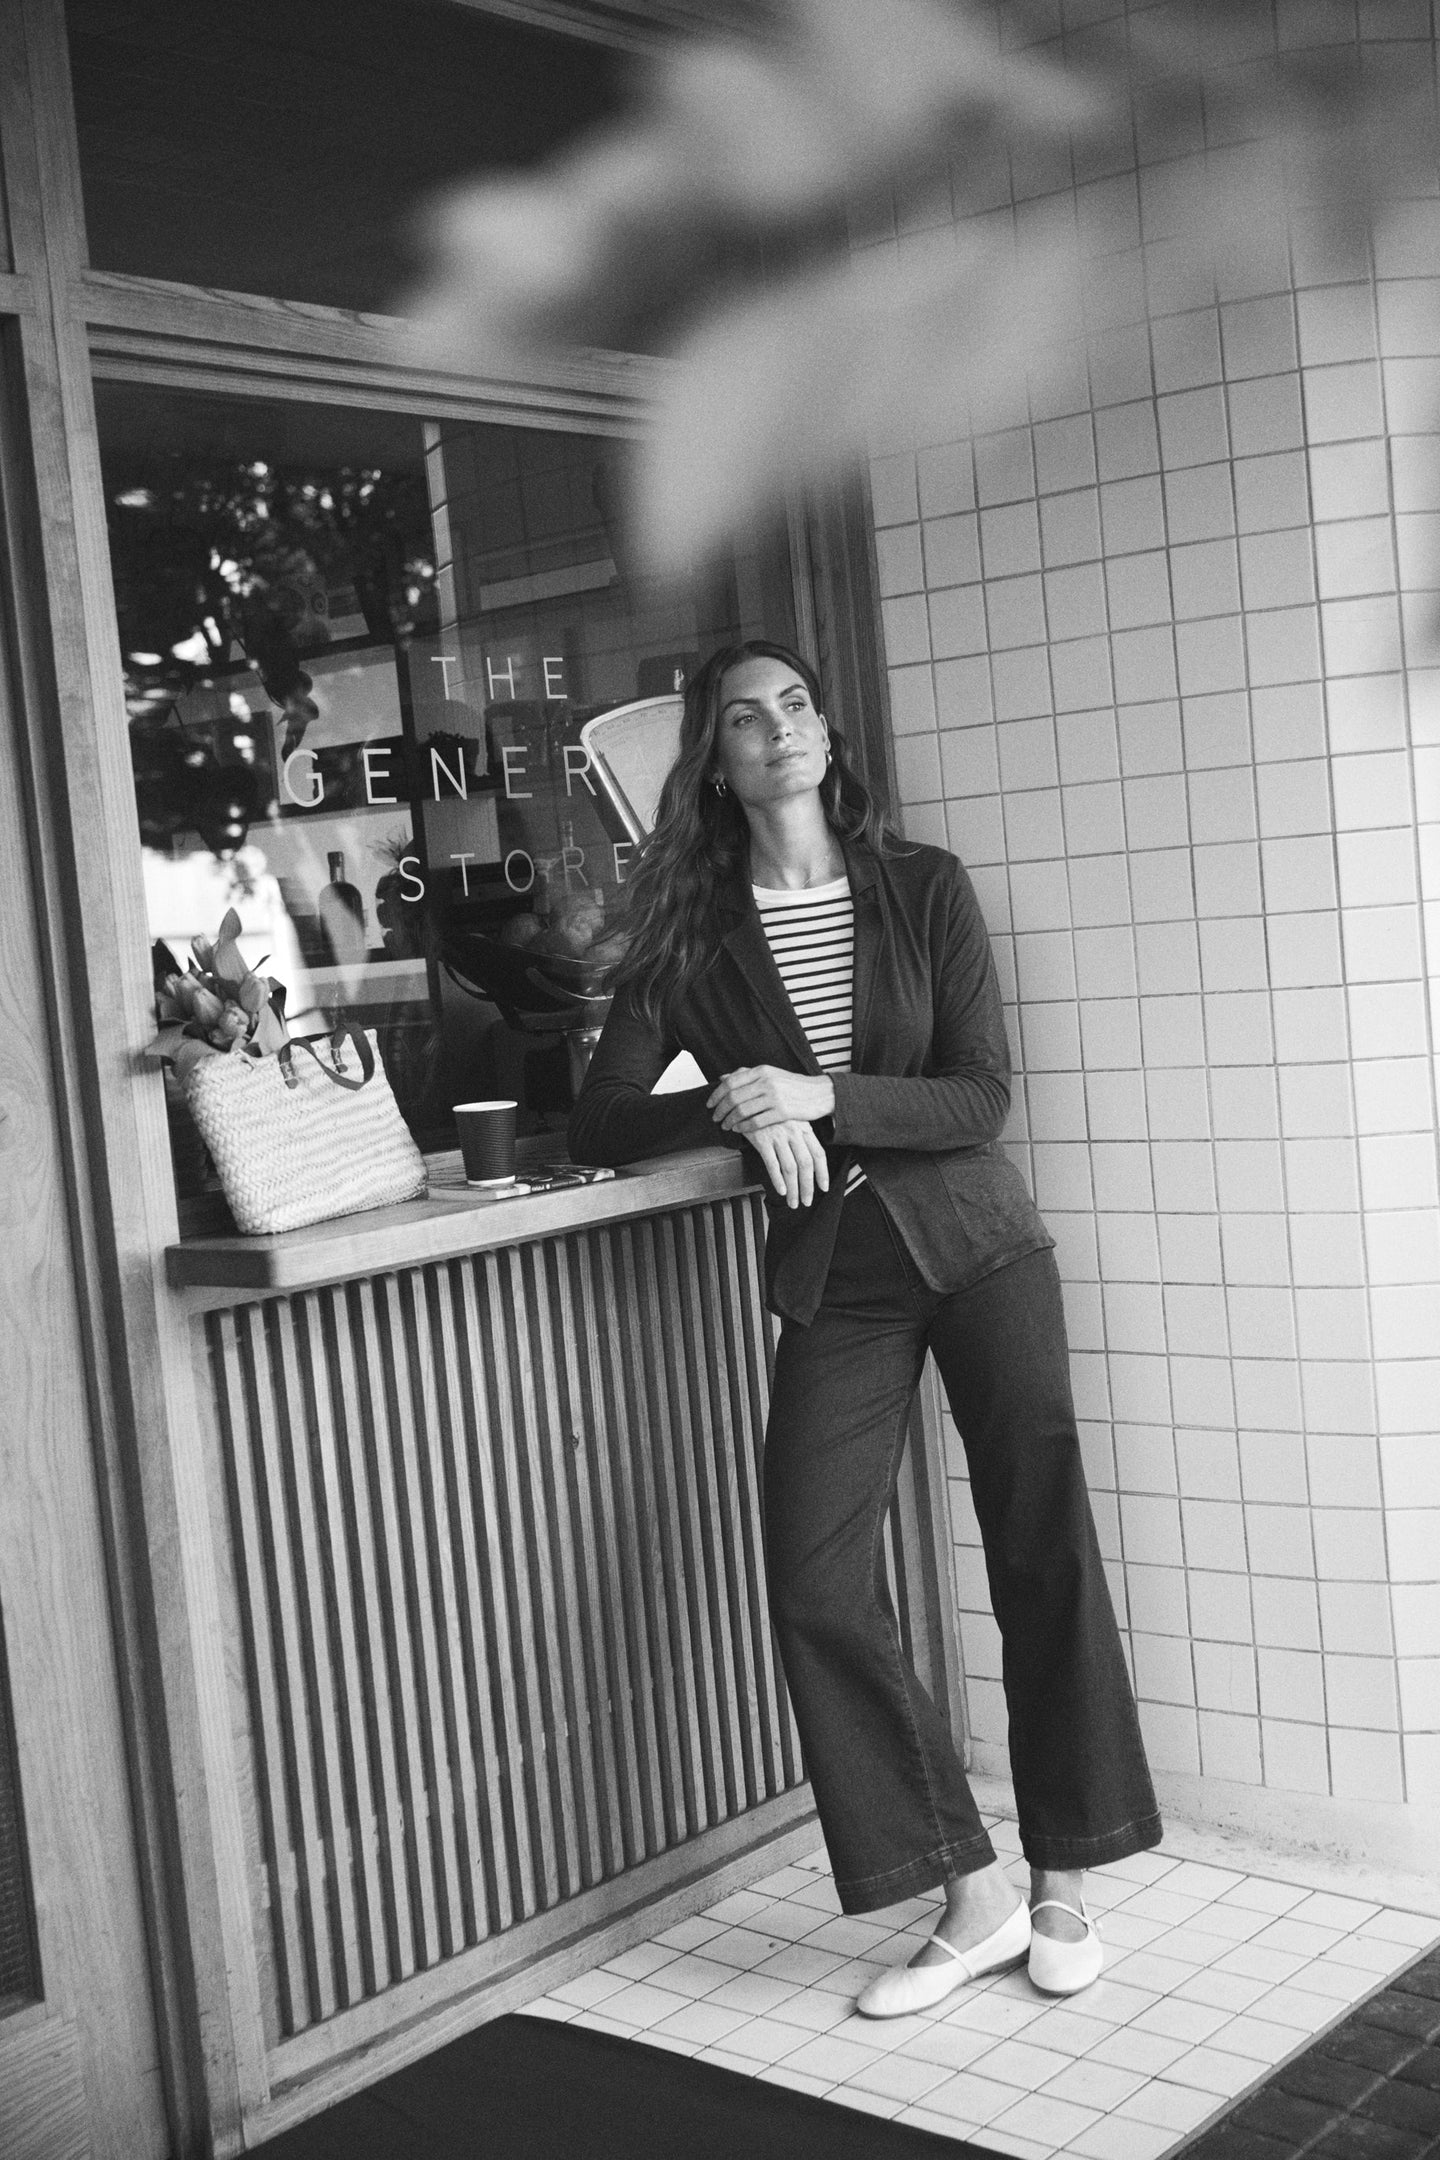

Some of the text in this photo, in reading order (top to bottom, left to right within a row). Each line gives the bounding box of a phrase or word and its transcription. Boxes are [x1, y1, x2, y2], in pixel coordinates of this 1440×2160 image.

[431, 656, 567, 700] THE
[283, 746, 653, 807] GENER
[399, 842, 632, 903] STORE
